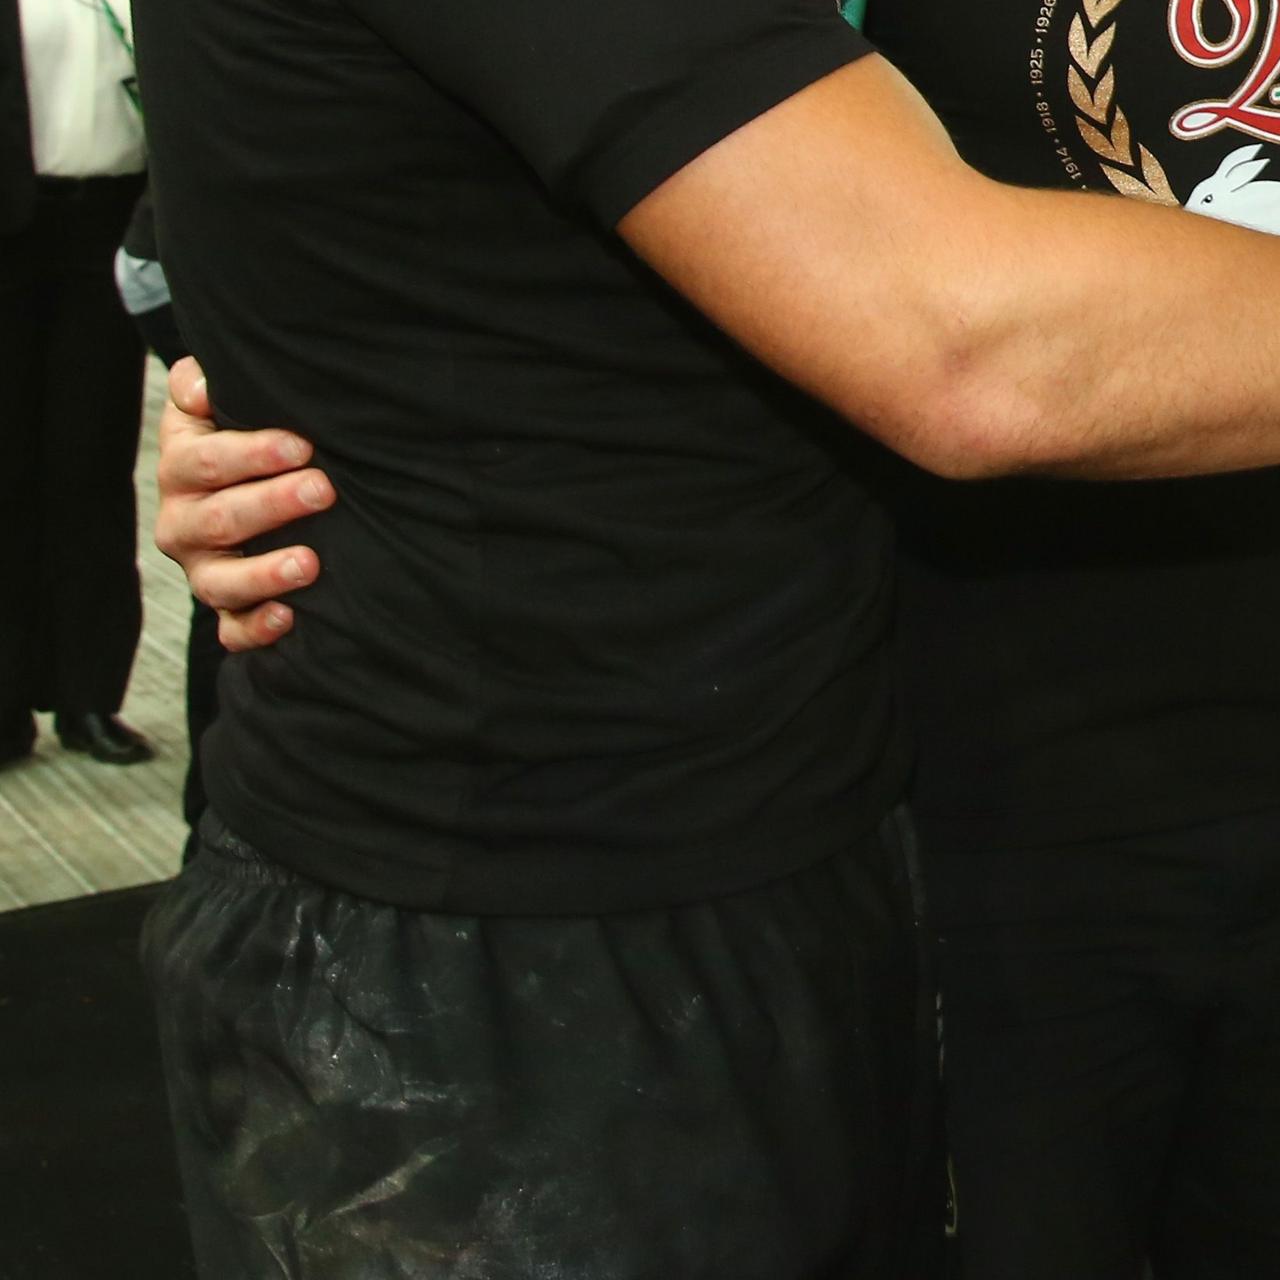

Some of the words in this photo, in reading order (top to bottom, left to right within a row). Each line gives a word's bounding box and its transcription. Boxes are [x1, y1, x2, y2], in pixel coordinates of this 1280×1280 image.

[1029, 48, 1045, 86] 1925
[1036, 101, 1058, 134] 1918
[1056, 147, 1082, 181] 1914
